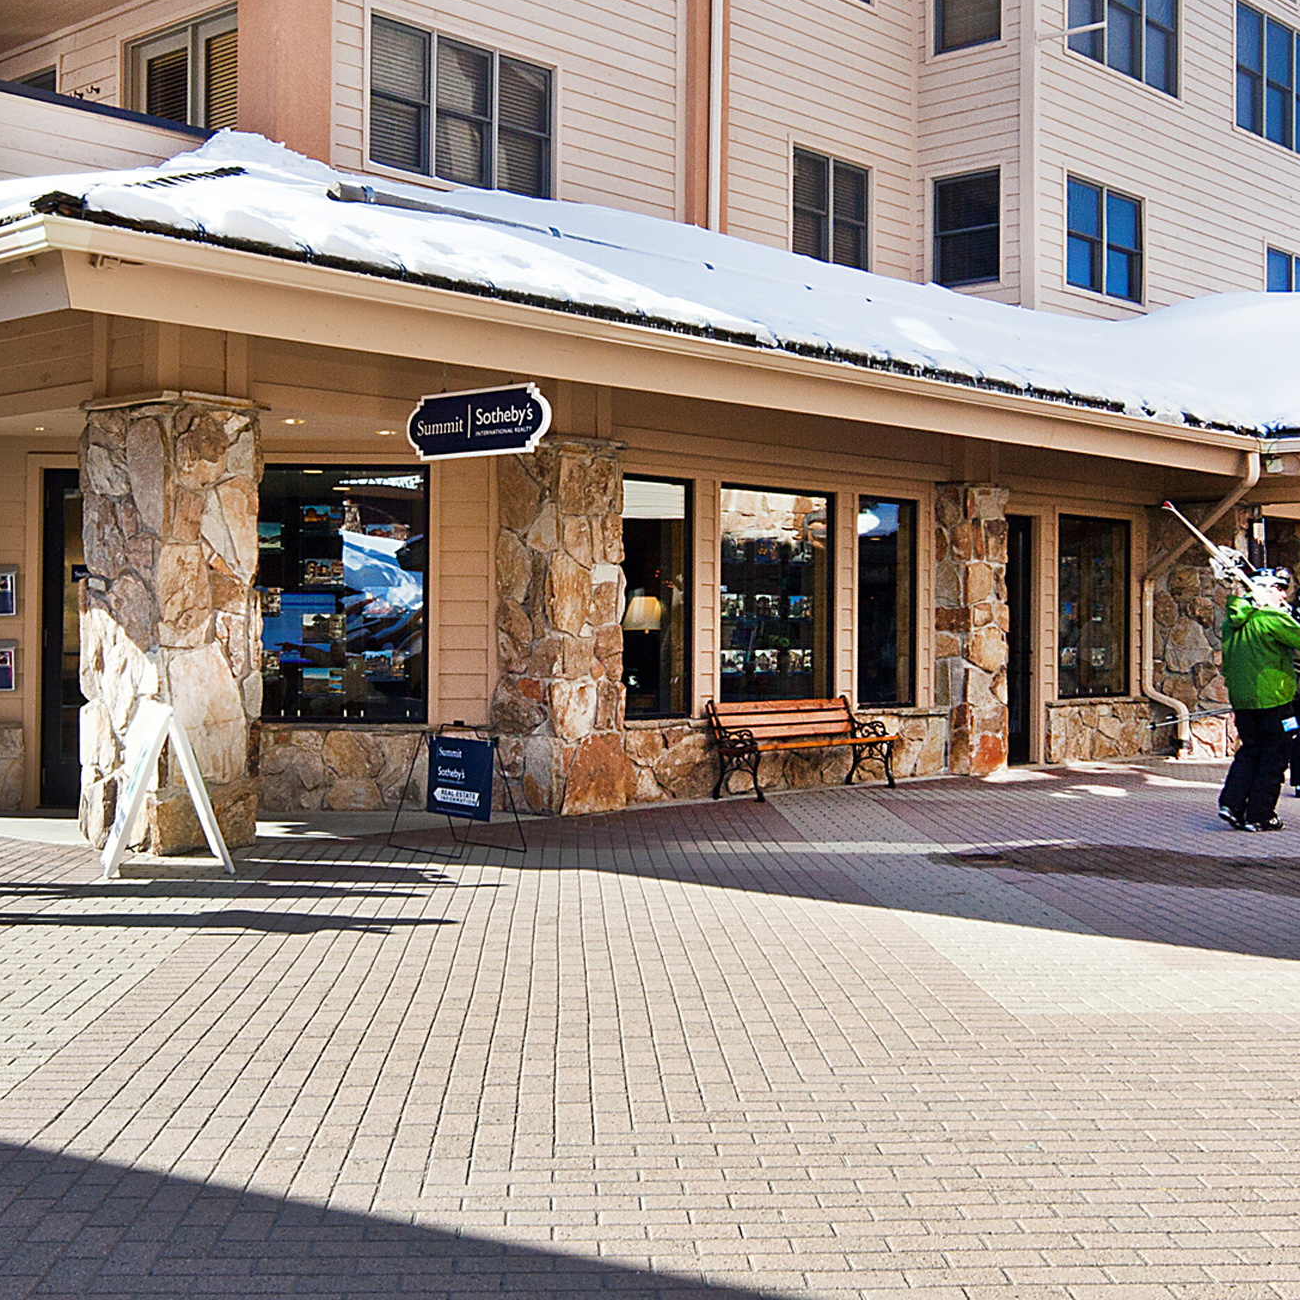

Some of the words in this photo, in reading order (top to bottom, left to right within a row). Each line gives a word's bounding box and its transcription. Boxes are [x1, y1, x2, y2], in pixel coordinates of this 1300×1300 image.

[416, 416, 464, 437] Summit
[475, 402, 534, 426] Sotheby's
[475, 427, 514, 437] INTERNATIONAL
[514, 425, 533, 433] REALTY
[437, 766, 466, 781] Sotheby's
[440, 795, 476, 805] INFORMATION
[441, 789, 455, 797] REAL
[455, 790, 476, 800] ESTATE
